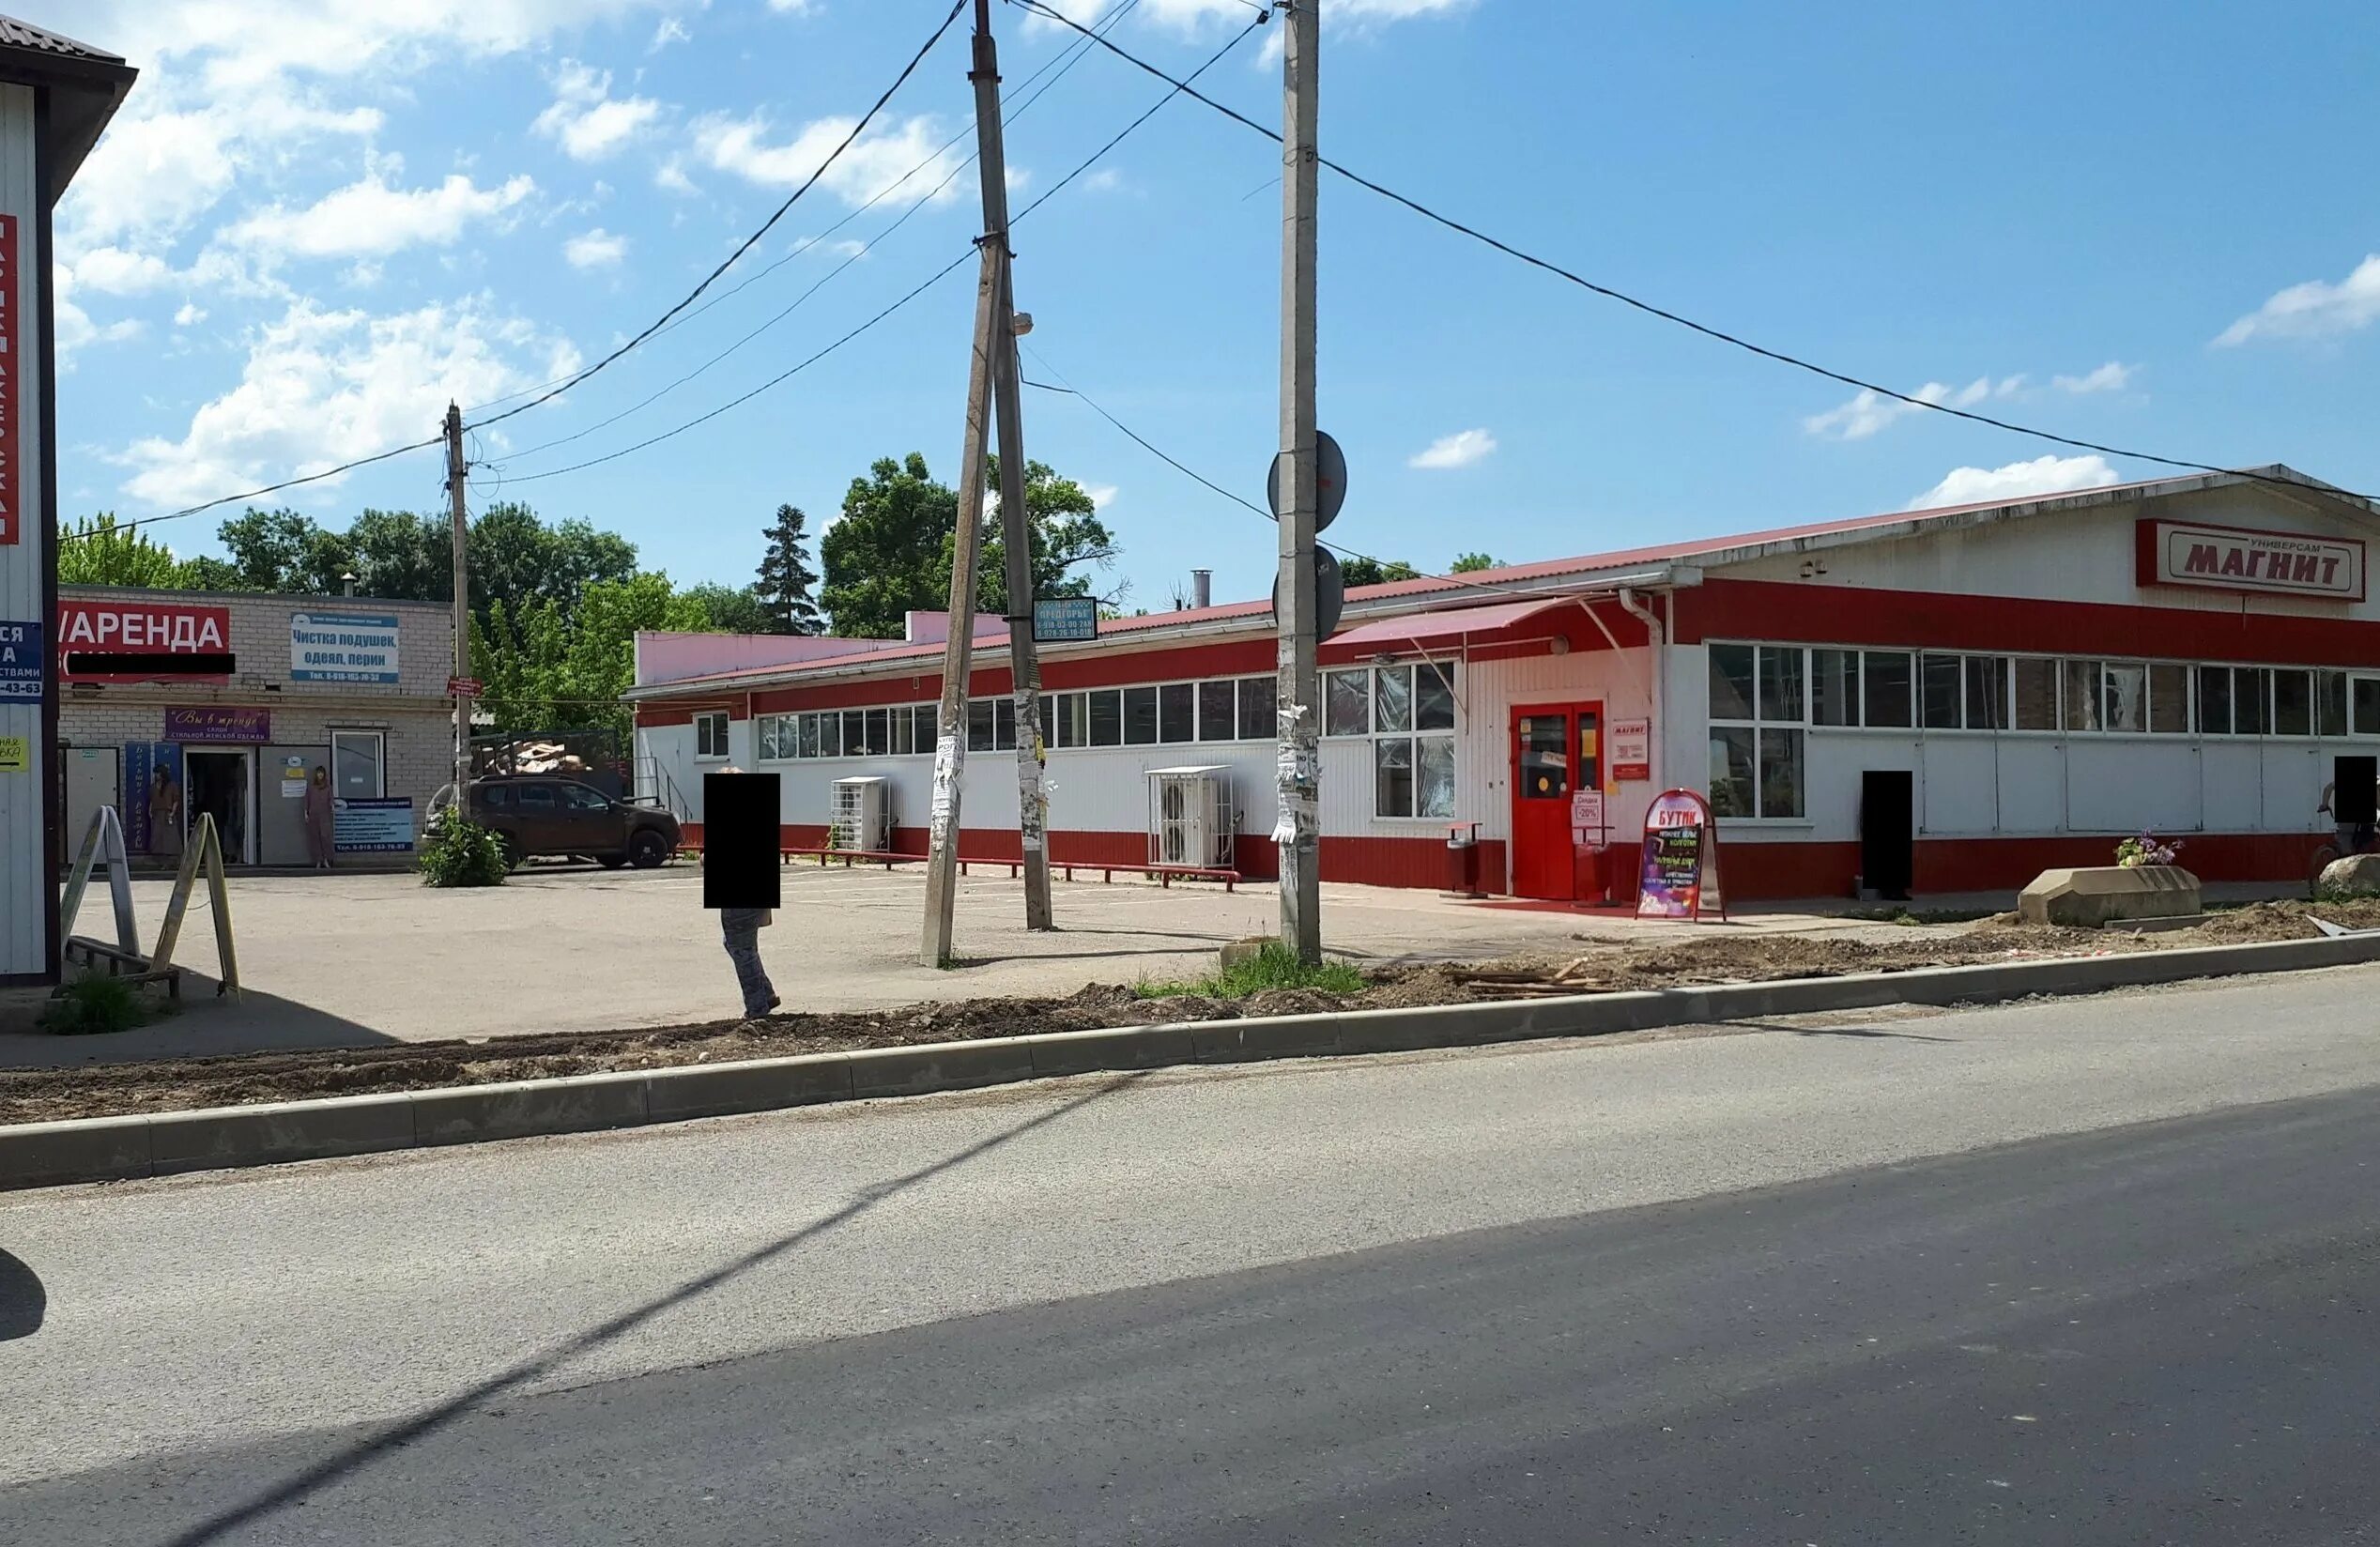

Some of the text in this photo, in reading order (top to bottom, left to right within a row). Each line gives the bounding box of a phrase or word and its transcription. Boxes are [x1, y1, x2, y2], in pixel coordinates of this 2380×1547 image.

[2250, 539, 2321, 553] УНИВЕРСАМ
[2184, 544, 2340, 585] МАГНИТ
[293, 629, 397, 648] Чистка подушек,
[304, 651, 386, 666] одеял, перин
[1659, 810, 1696, 826] БУТИК
